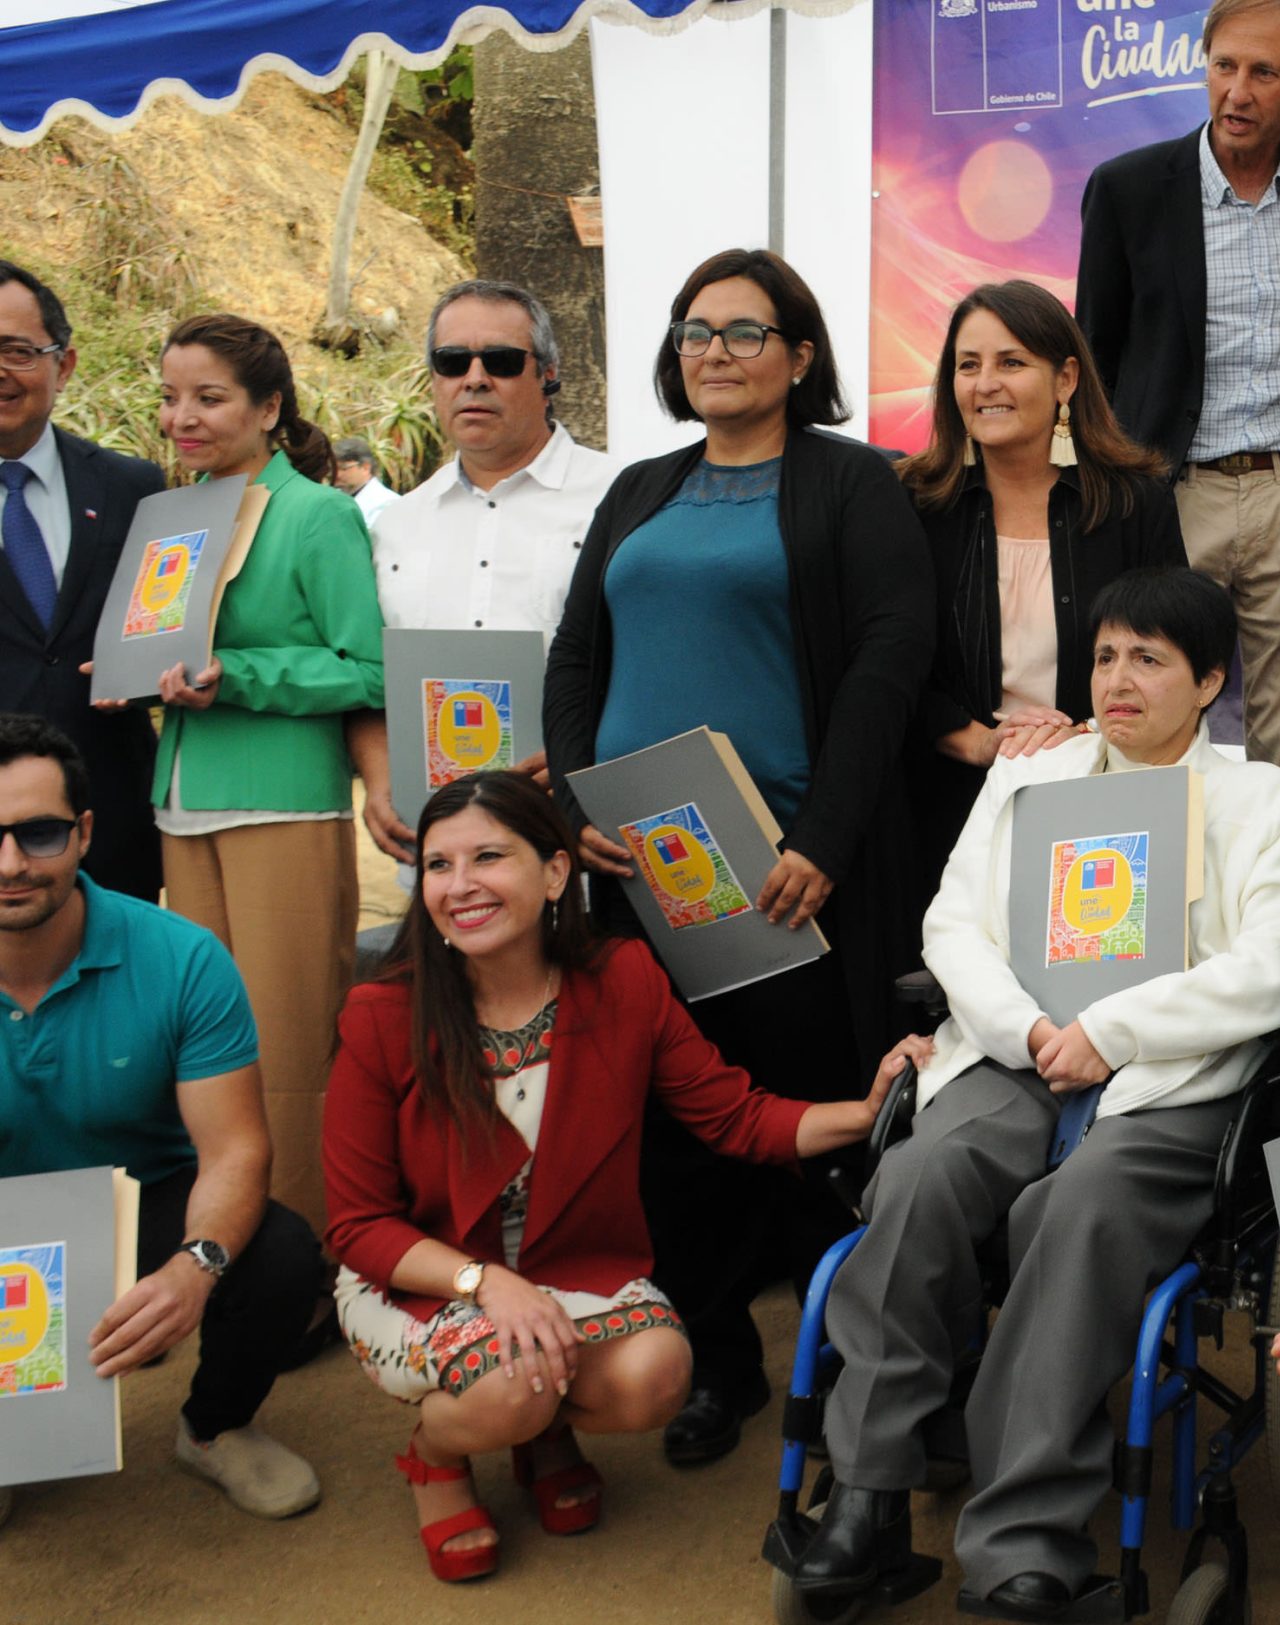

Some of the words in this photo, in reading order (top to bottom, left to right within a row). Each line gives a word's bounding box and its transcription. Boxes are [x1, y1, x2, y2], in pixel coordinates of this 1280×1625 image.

[1114, 15, 1140, 42] la
[990, 94, 1024, 104] Gobierno
[1025, 92, 1035, 102] de
[1036, 91, 1056, 101] Chile
